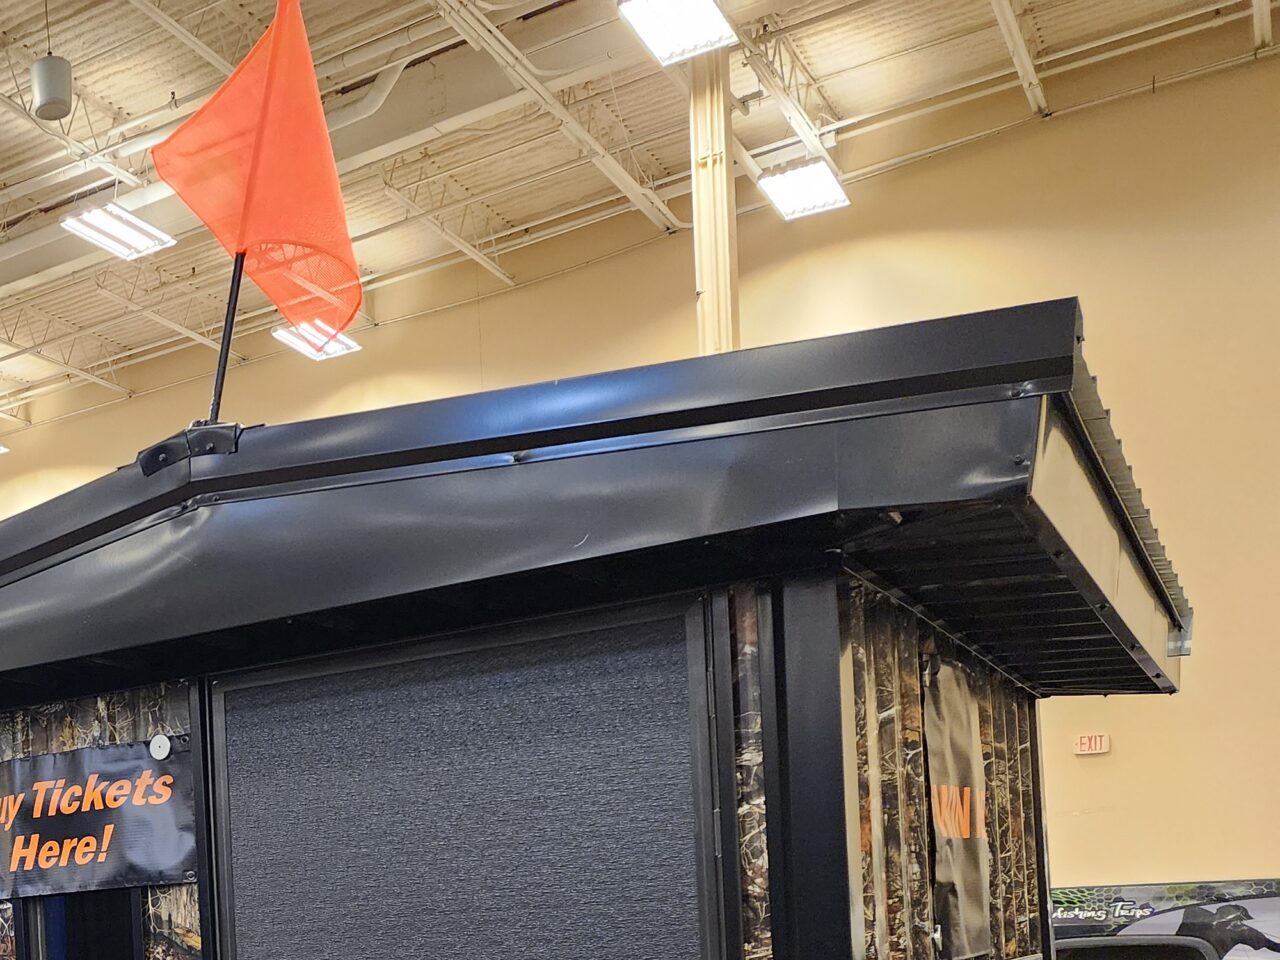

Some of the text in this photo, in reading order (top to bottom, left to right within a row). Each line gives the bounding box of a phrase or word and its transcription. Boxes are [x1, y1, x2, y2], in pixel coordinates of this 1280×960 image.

[1079, 734, 1105, 752] EXIT
[32, 769, 174, 818] Tickets
[9, 823, 115, 873] Here!
